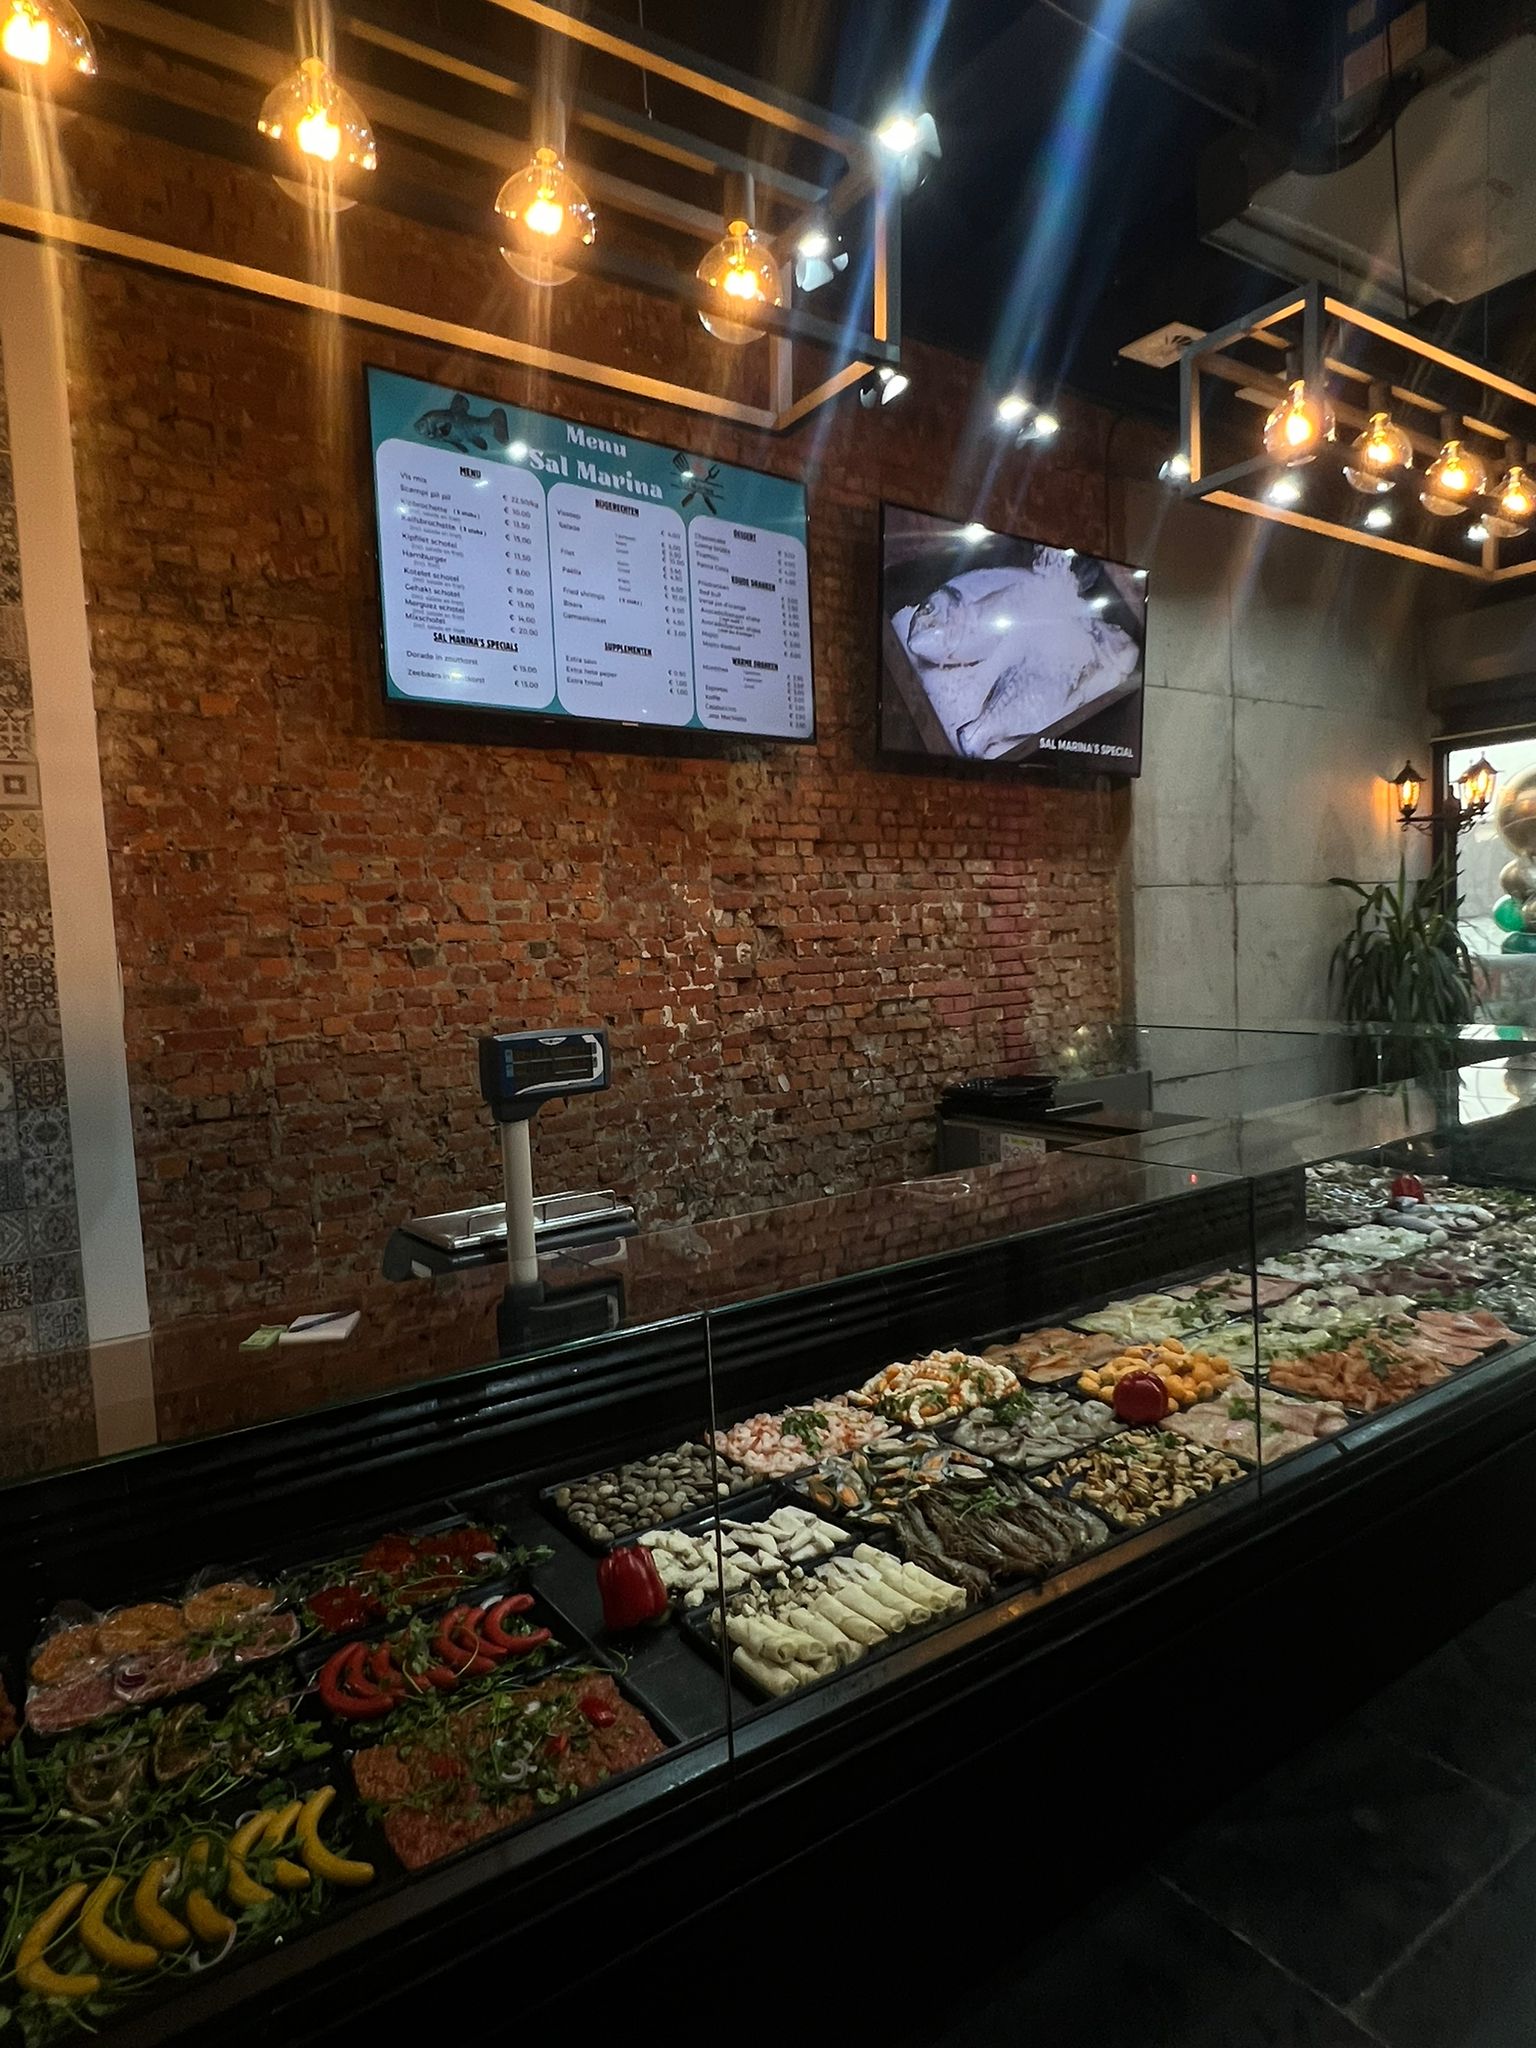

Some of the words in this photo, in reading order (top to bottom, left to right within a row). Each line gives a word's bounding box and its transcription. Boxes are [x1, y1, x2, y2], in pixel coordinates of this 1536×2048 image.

[566, 424, 627, 458] Menu
[460, 466, 481, 479] MENU
[529, 449, 568, 477] Sal
[577, 460, 663, 500] Marina
[433, 632, 448, 644] SAL
[449, 634, 485, 648] MARINA'S
[486, 639, 518, 653] SPECIALS
[604, 642, 652, 658] SUPPLEMENTEN
[1040, 738, 1056, 750] SAL
[1058, 739, 1100, 754] MARINA'S
[1100, 744, 1134, 758] SPECIAL
